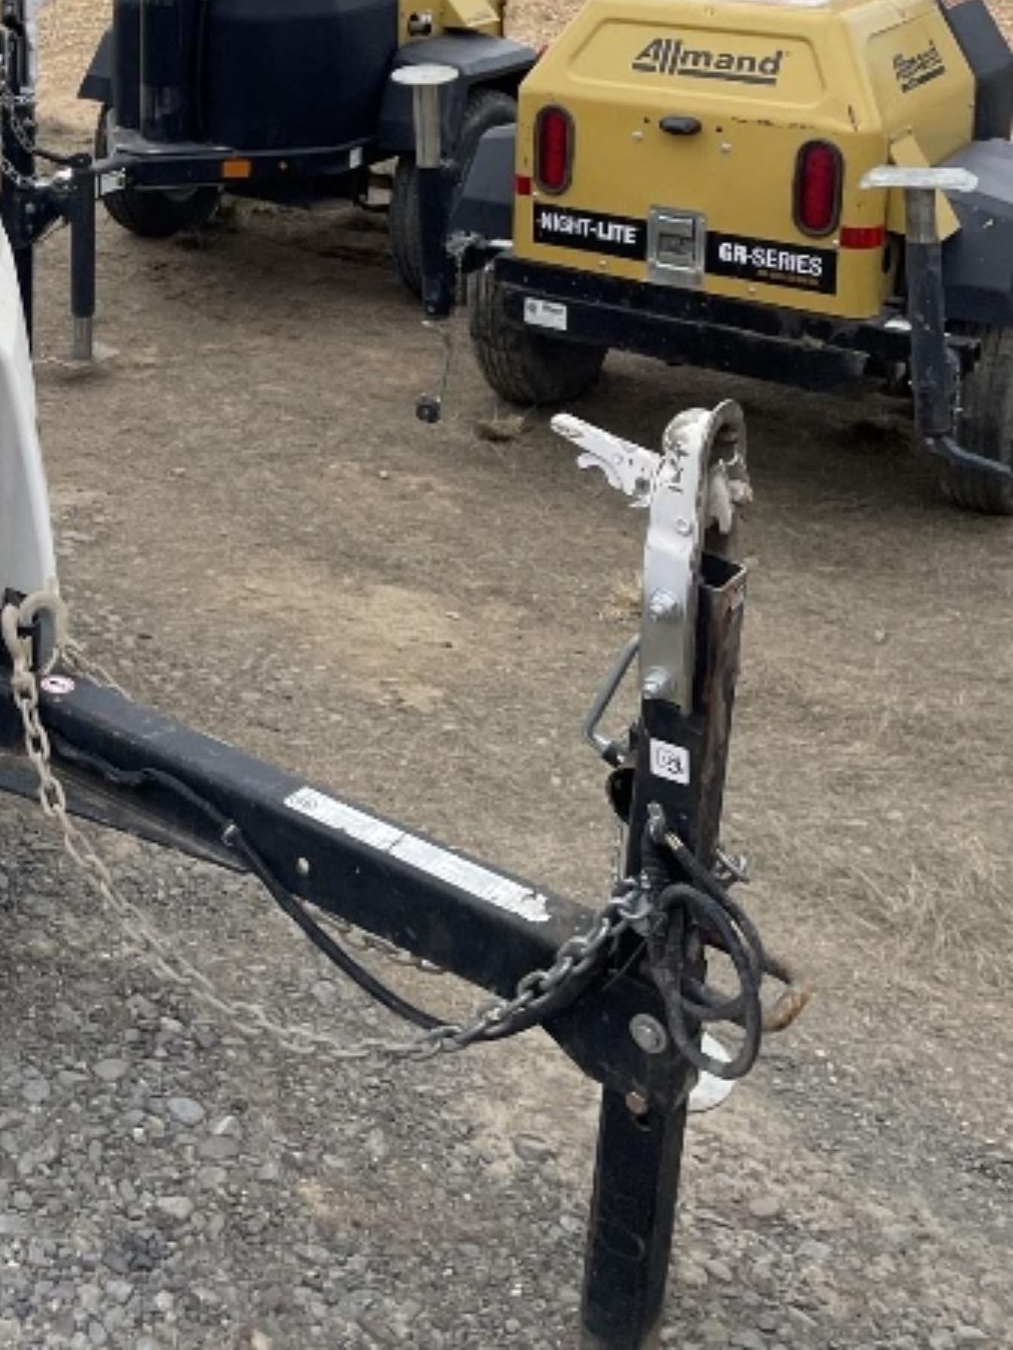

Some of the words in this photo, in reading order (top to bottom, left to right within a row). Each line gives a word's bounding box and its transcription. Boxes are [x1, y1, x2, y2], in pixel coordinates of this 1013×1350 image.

[633, 38, 785, 80] Allmand
[540, 211, 637, 245] NIGHT-LITE
[718, 241, 823, 277] GR-SERIES
